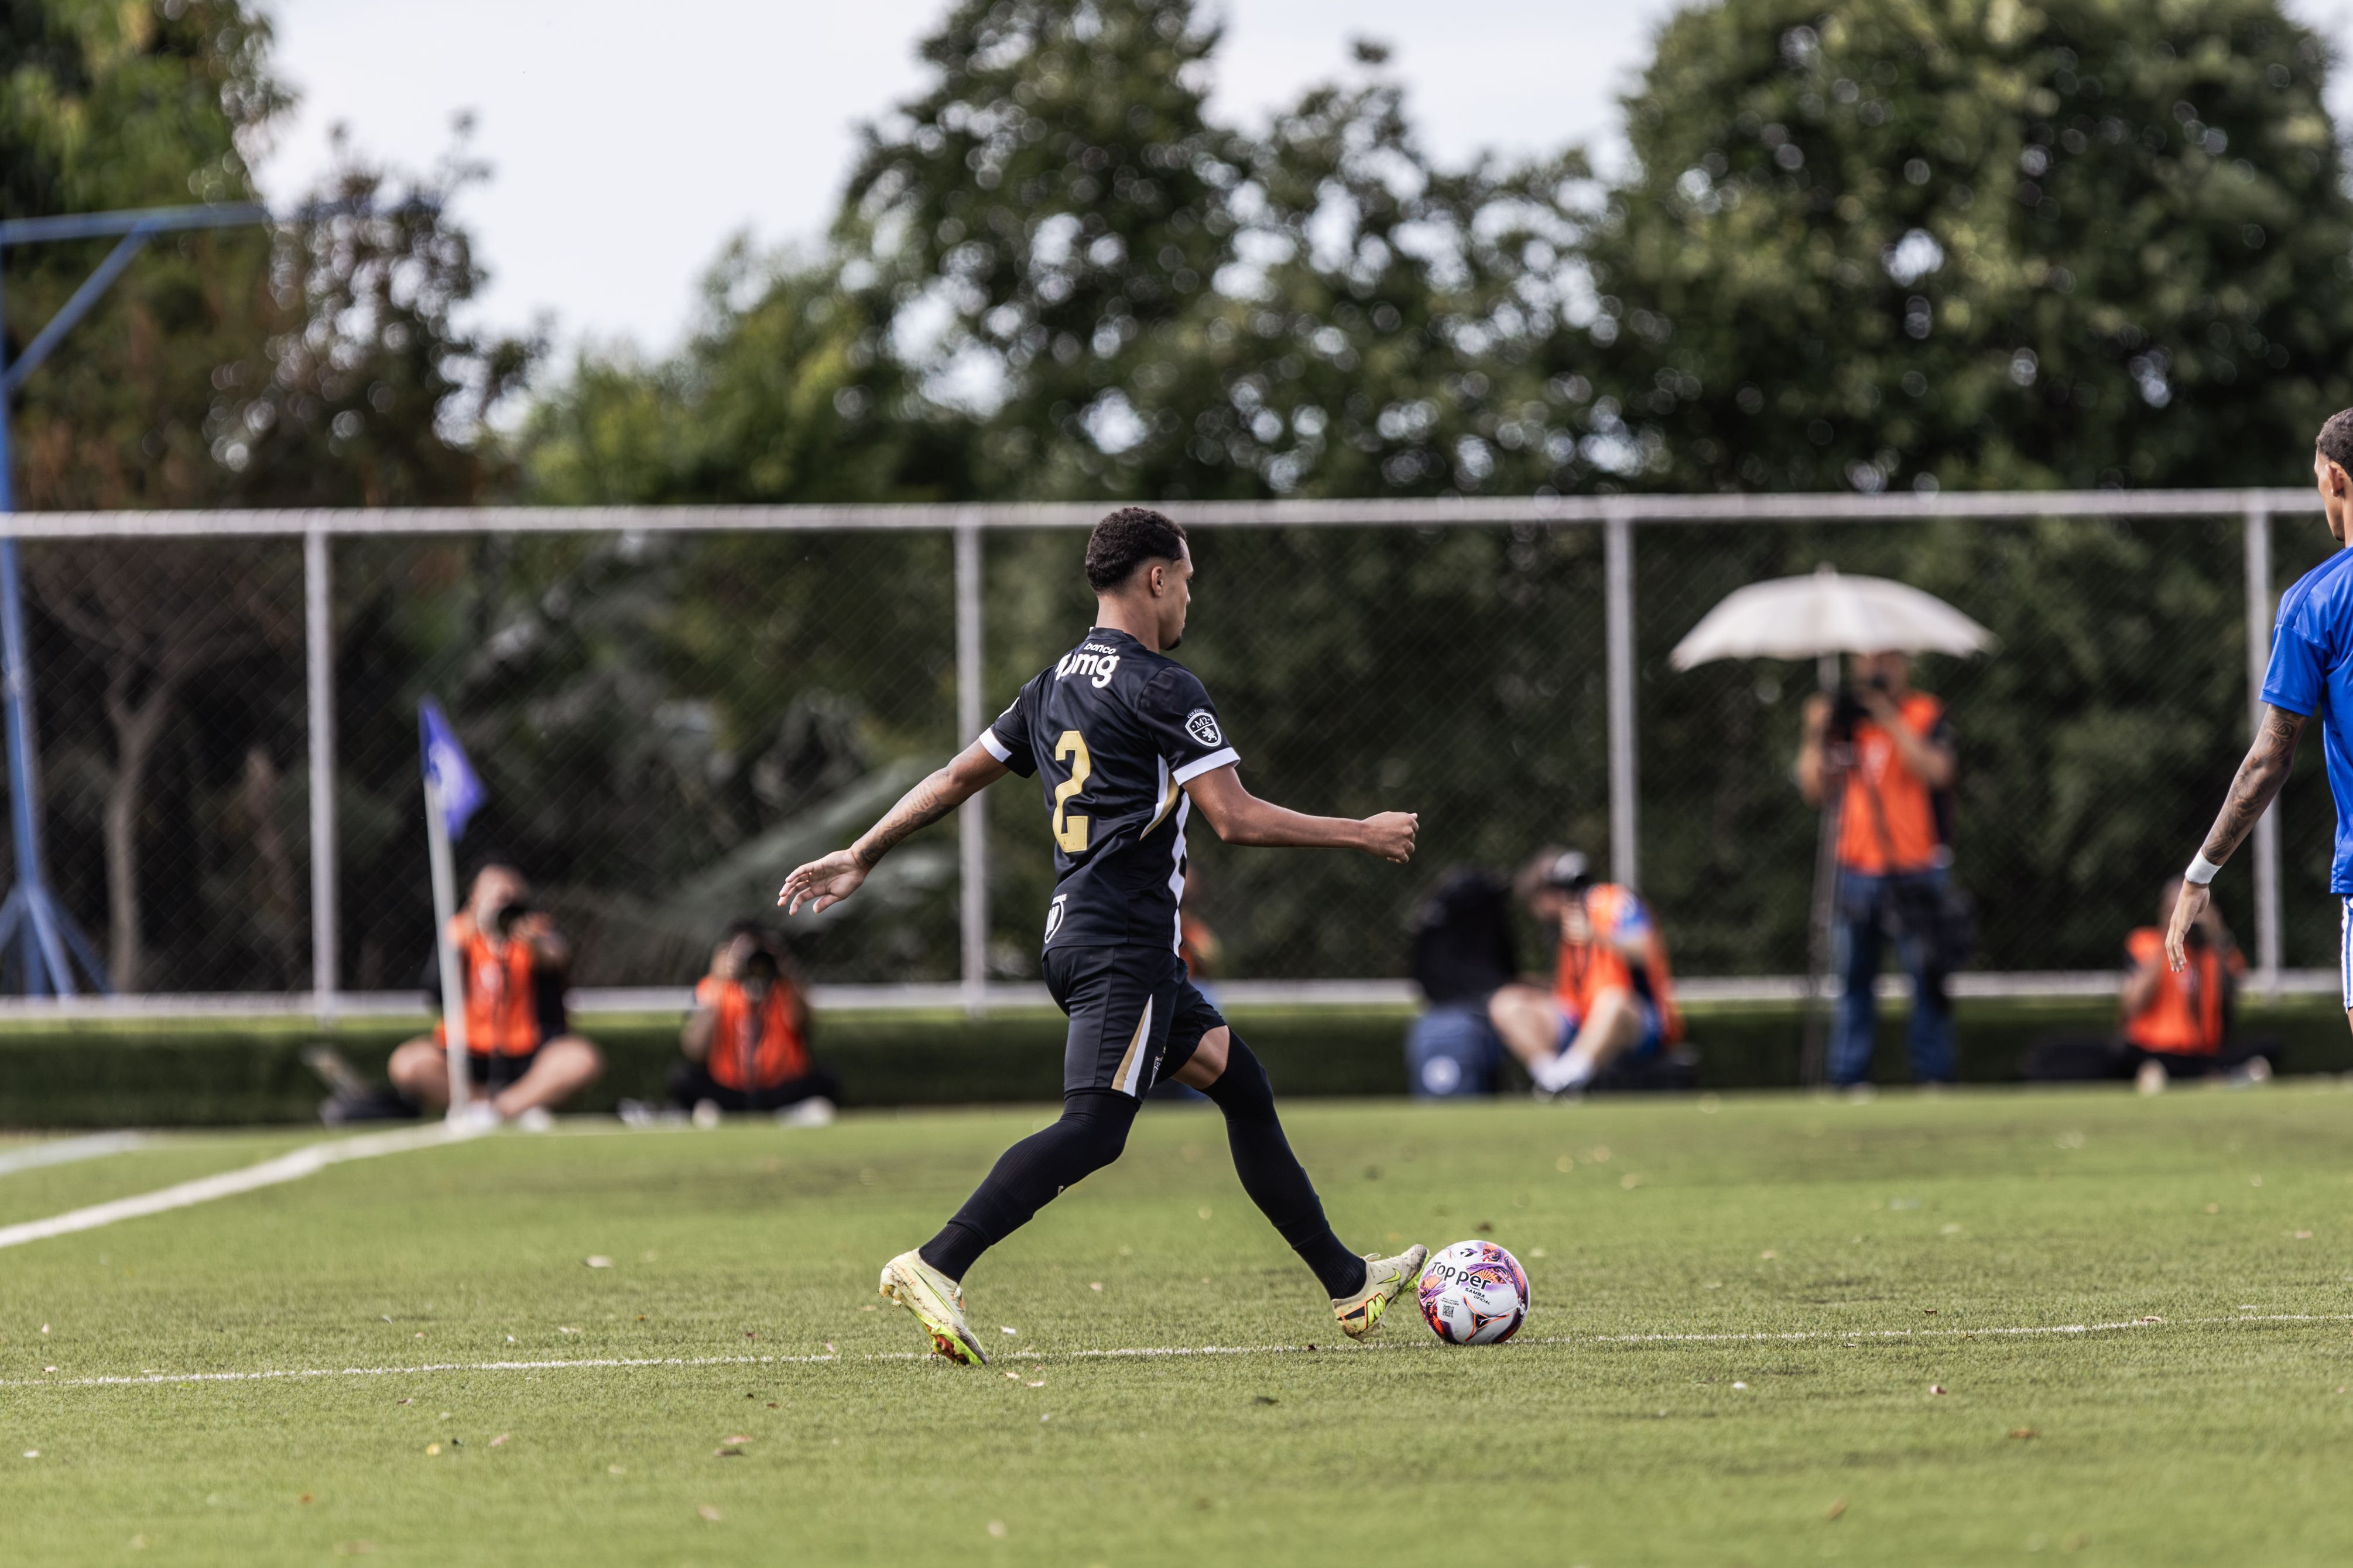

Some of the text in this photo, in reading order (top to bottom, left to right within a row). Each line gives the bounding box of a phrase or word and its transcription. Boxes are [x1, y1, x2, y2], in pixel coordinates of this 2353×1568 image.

[1083, 643, 1116, 654] banco
[1052, 730, 1091, 853] 2
[1431, 1262, 1491, 1290] Topper
[1465, 1288, 1485, 1298] SAMBA
[1473, 1295, 1491, 1305] OFICIAL
